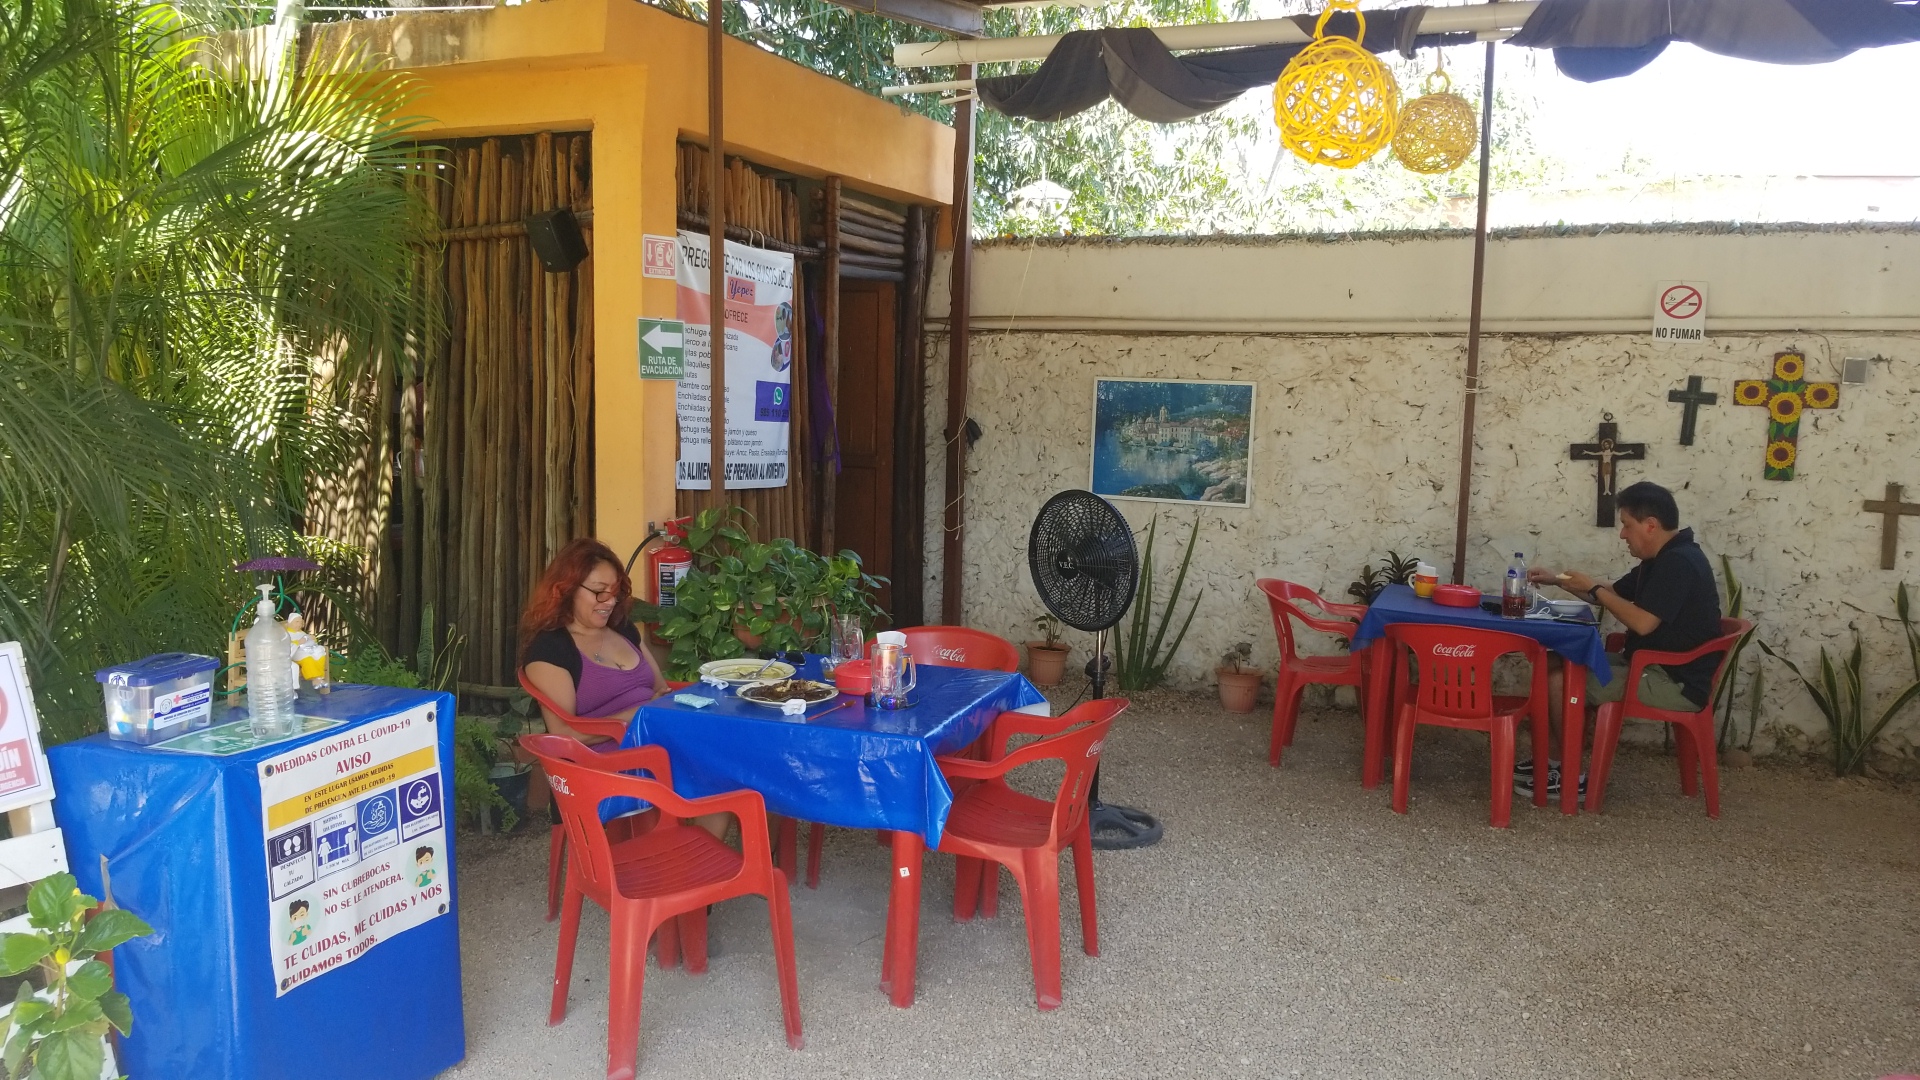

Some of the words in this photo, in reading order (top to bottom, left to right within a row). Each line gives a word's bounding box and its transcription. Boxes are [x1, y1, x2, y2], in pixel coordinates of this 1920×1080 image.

[648, 267, 671, 276] EXTINTOR
[725, 308, 748, 324] OFRECE
[1655, 327, 1668, 339] NO
[1670, 327, 1702, 340] FUMAR
[648, 356, 667, 366] RUTA
[667, 357, 677, 366] DE
[641, 364, 683, 376] EVACUACIÓN
[677, 379, 700, 390] Alambre
[677, 391, 707, 402] Enchiladas
[677, 402, 706, 412] Enchiladas
[724, 462, 733, 481] SE
[732, 462, 759, 481] PREPARAN
[758, 462, 766, 480] AL
[766, 462, 786, 480] MOMENTO
[1432, 643, 1476, 658] Coca-Cola
[274, 752, 317, 775] MEDIDAS
[319, 737, 356, 758] CONTRA
[357, 733, 369, 744] EL
[370, 718, 411, 742] COVID-19
[335, 751, 372, 775] AVISO
[304, 794, 312, 803] EN
[314, 788, 328, 798] ESTE
[328, 781, 348, 794] LUGAR
[348, 772, 370, 786] USAMOS
[370, 763, 394, 775] MEDIDAS
[304, 805, 313, 814] DE
[347, 786, 361, 798] ANTE
[361, 782, 368, 791] EL
[368, 776, 386, 789] COVID
[280, 855, 307, 870] DESINFECTA
[283, 874, 304, 888] CALZADO
[323, 886, 338, 900] SIN
[341, 861, 391, 893] CUBREBOCAS
[324, 905, 338, 917] NO
[340, 899, 352, 910] SE
[353, 893, 363, 904] LE
[284, 952, 299, 970] TE
[301, 931, 351, 961] CUIDAS,
[354, 919, 368, 938] ME
[368, 900, 408, 927] CUIDAS
[410, 894, 418, 907] Y
[420, 883, 443, 903] NOS
[345, 934, 378, 959] TODOS.
